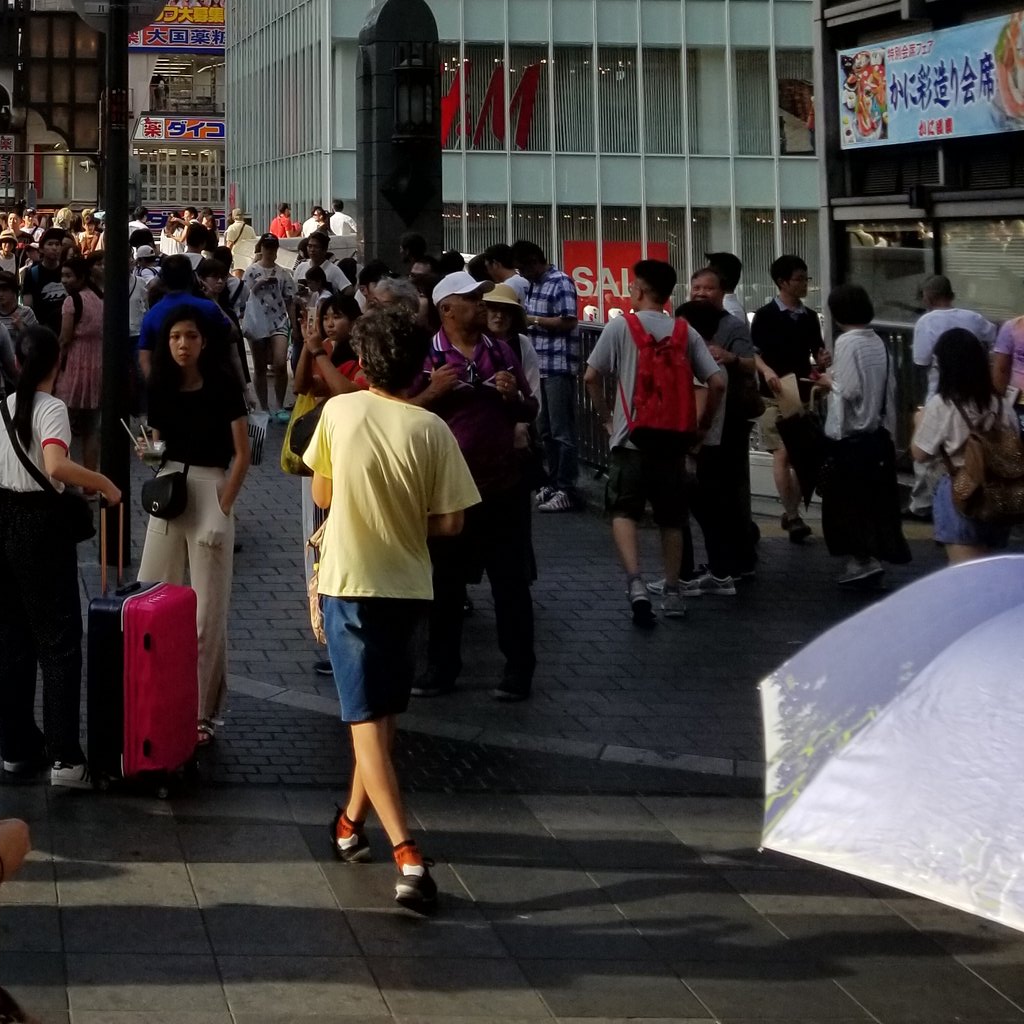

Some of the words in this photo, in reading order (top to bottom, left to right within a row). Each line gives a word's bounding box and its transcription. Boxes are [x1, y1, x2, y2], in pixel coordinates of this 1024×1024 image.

[167, 120, 225, 138] ダイコ
[571, 266, 632, 298] SAL
